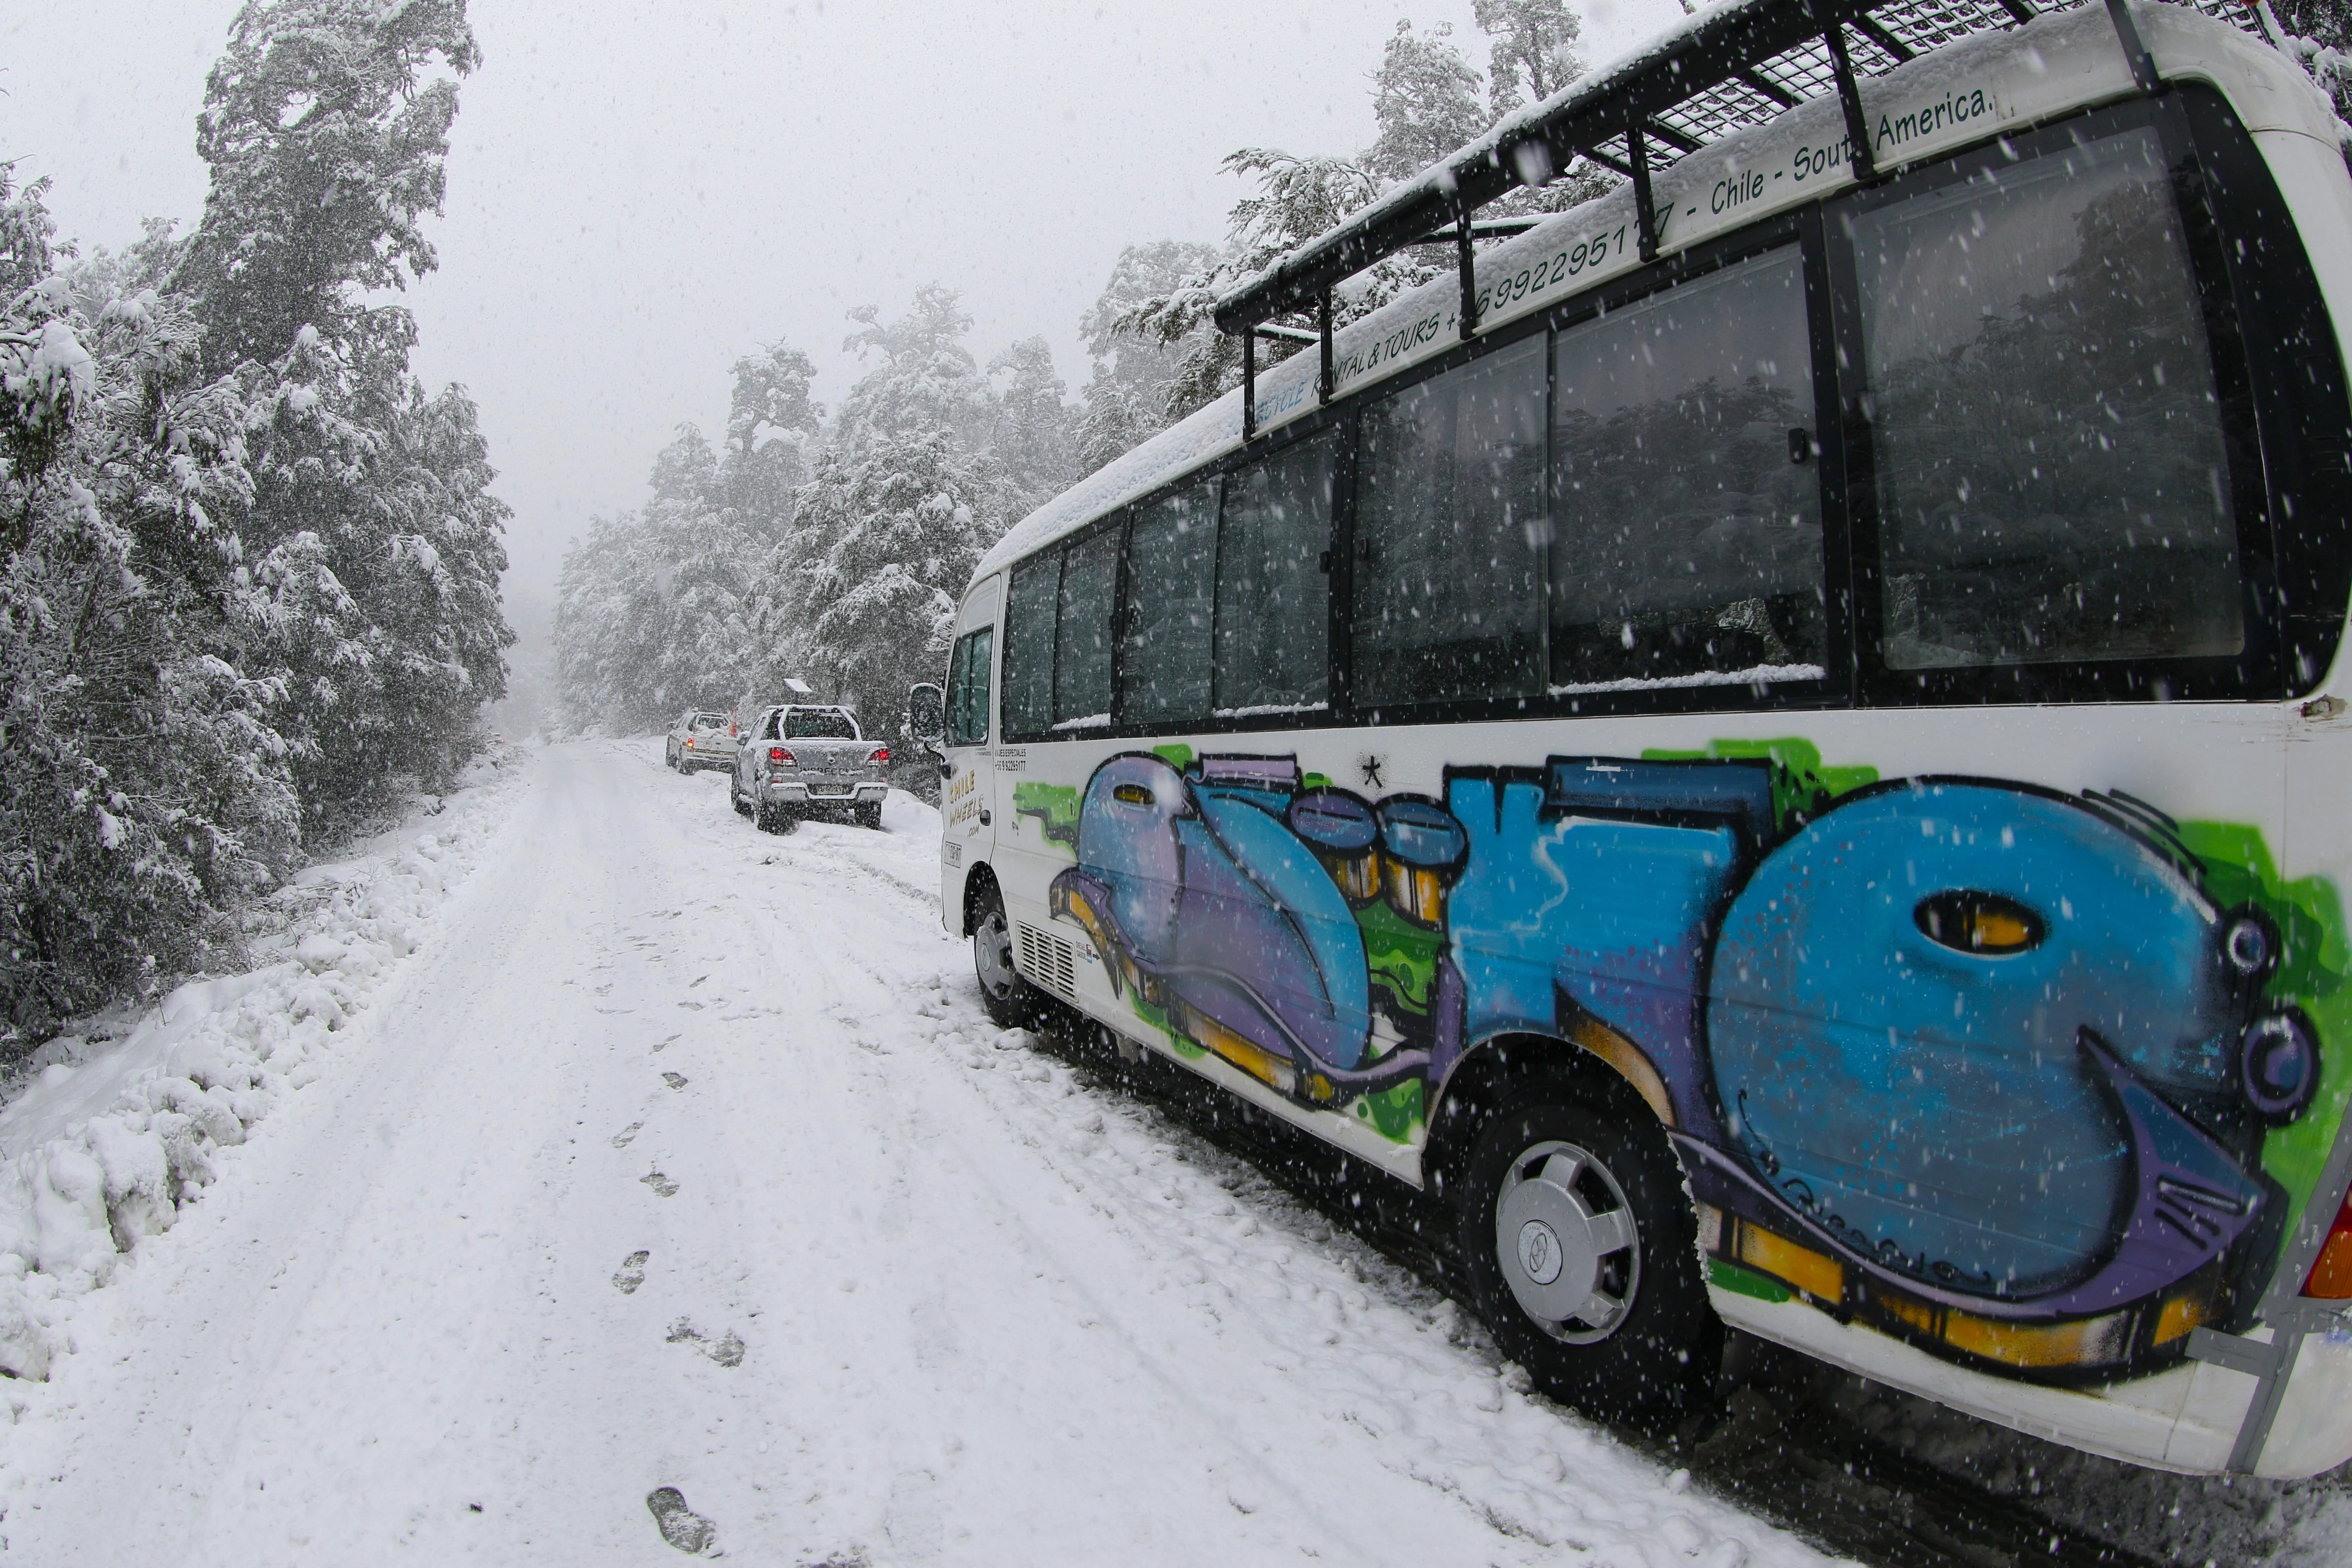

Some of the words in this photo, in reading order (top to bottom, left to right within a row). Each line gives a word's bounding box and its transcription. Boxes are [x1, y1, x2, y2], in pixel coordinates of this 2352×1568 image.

[1310, 351, 1365, 397] RNTAL
[1367, 341, 1379, 369] &
[1384, 312, 1439, 365] TOURS
[1447, 202, 1675, 332] +699229517
[1712, 169, 1764, 214] Chile
[1794, 133, 1852, 181] Sout
[1876, 89, 1993, 150] America.
[1005, 760, 1026, 772] 92295177
[949, 769, 975, 804] CHILE
[950, 794, 984, 828] WHEELS
[967, 824, 980, 837] .COM
